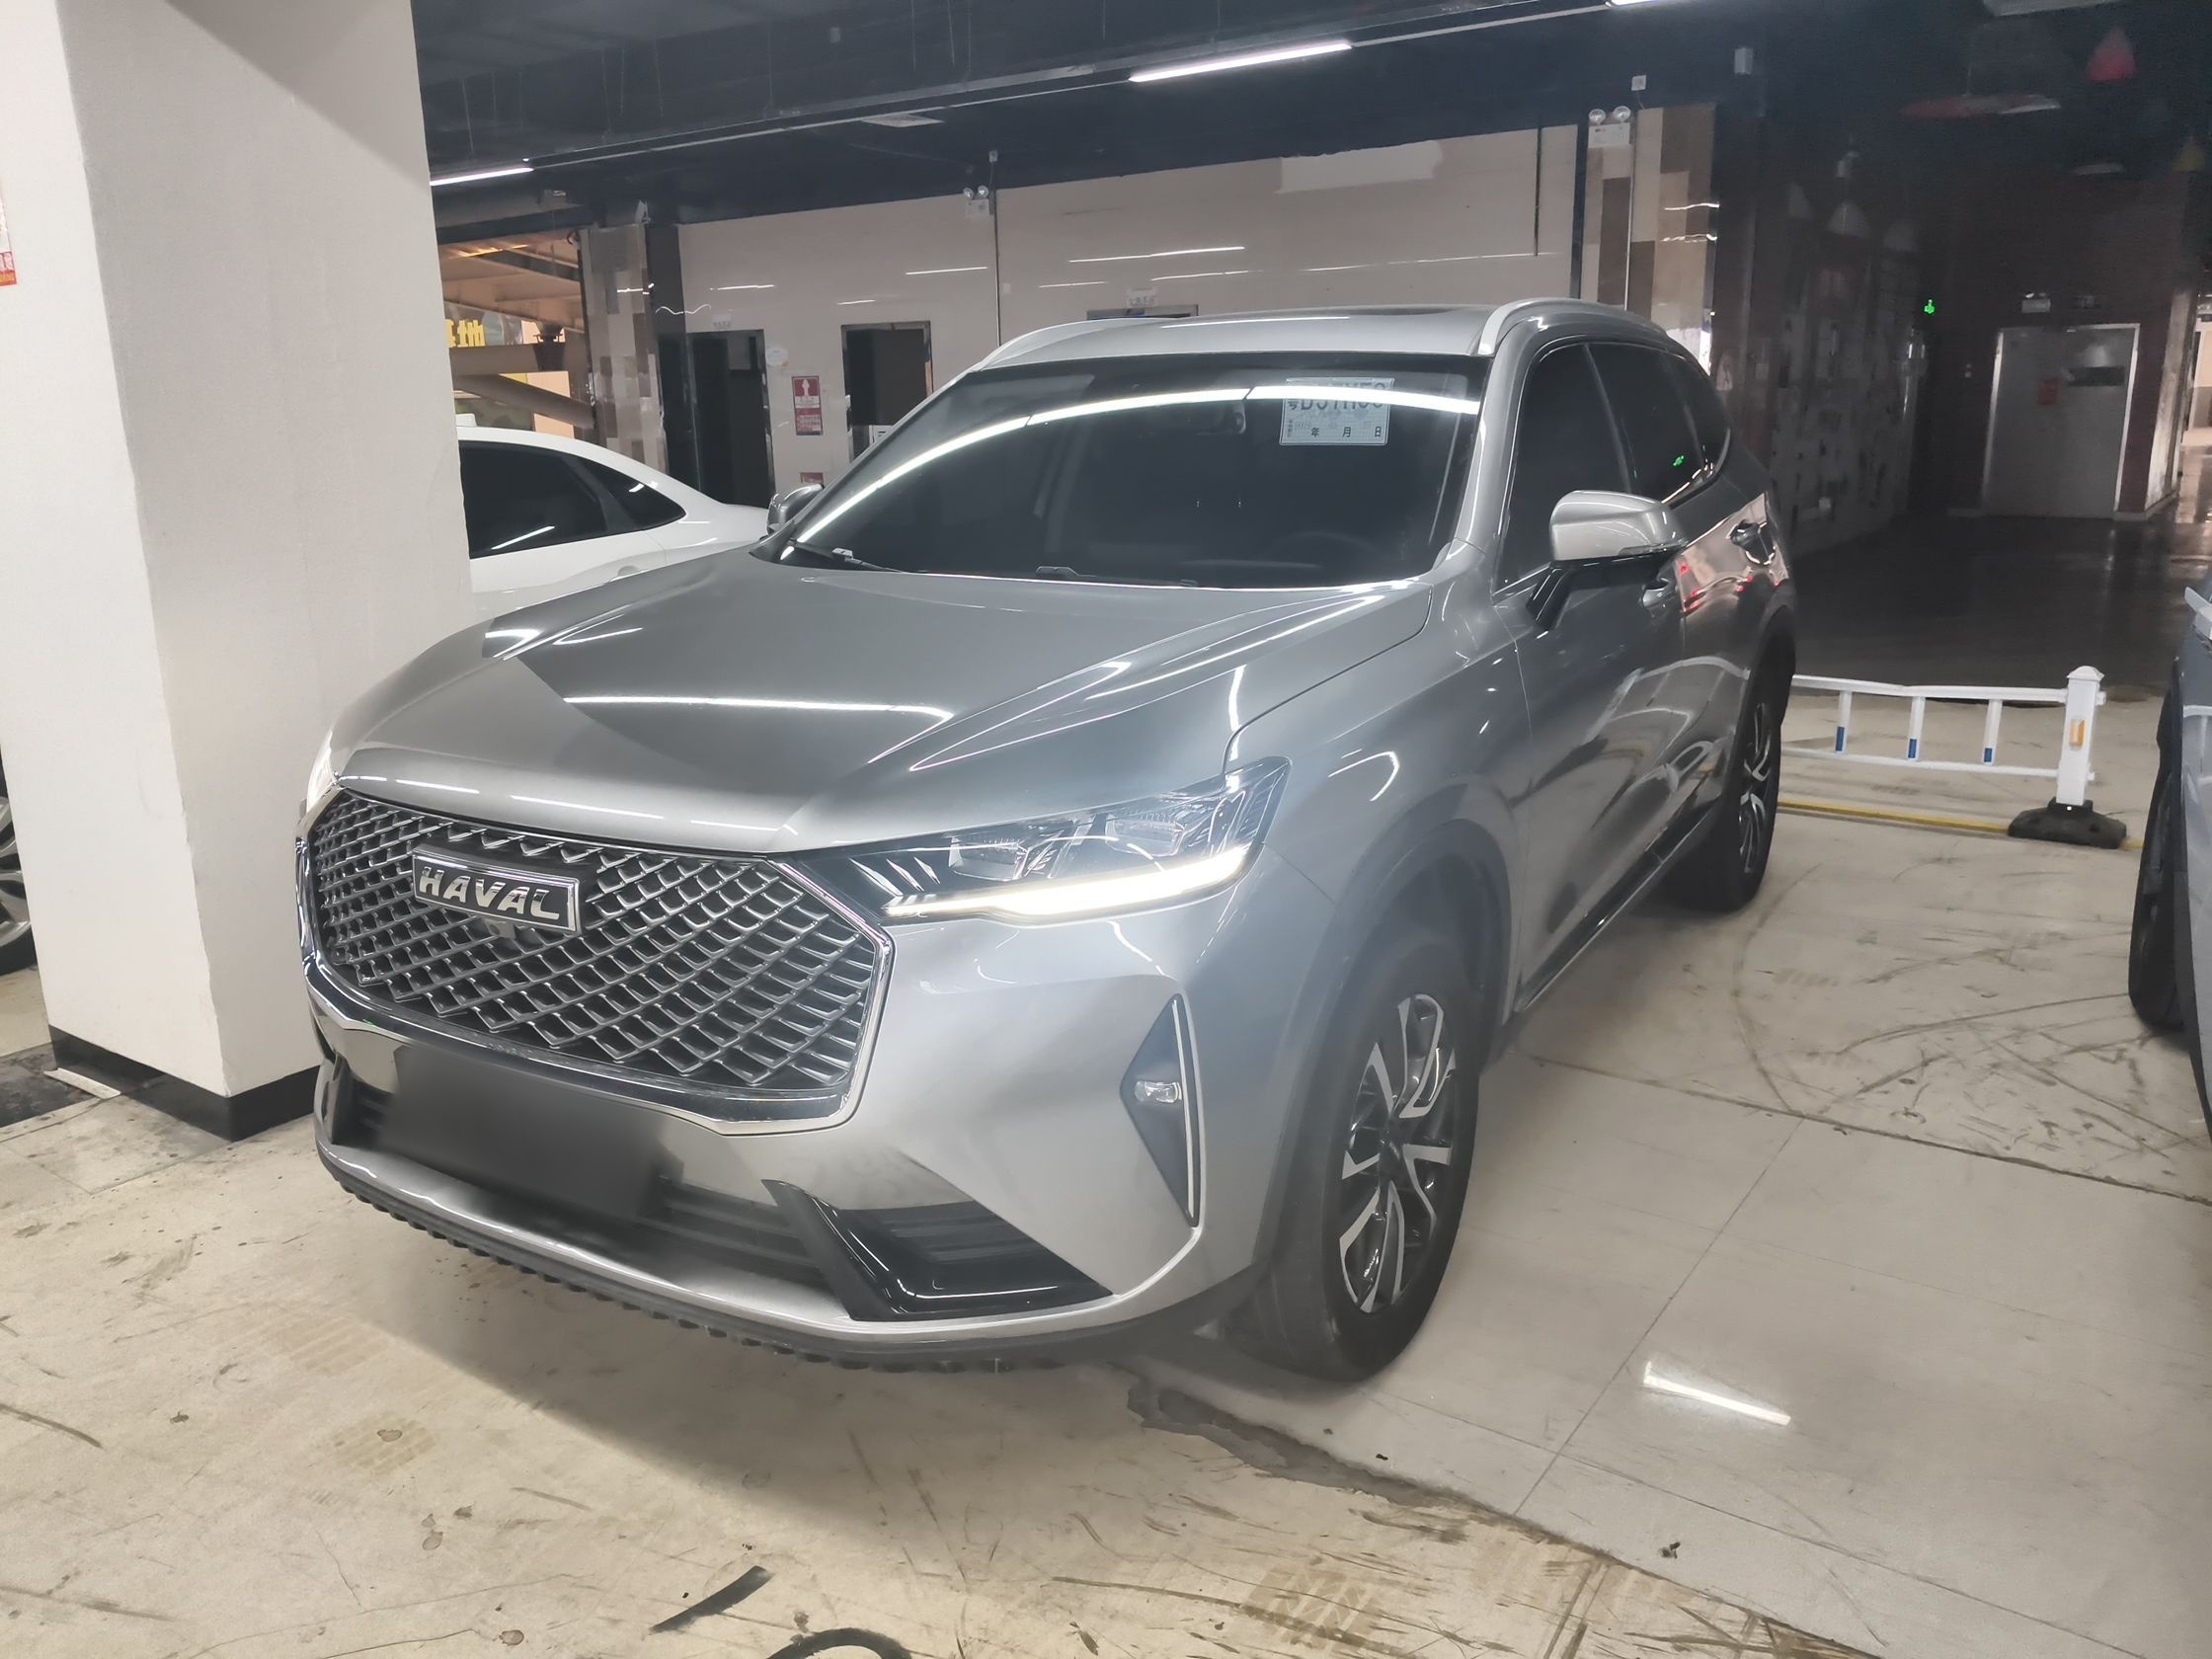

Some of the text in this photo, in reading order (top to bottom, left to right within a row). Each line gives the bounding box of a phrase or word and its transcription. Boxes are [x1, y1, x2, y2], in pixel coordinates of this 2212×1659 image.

[1311, 426, 1382, 437] 年 月 日
[419, 866, 560, 920] HAVAL
